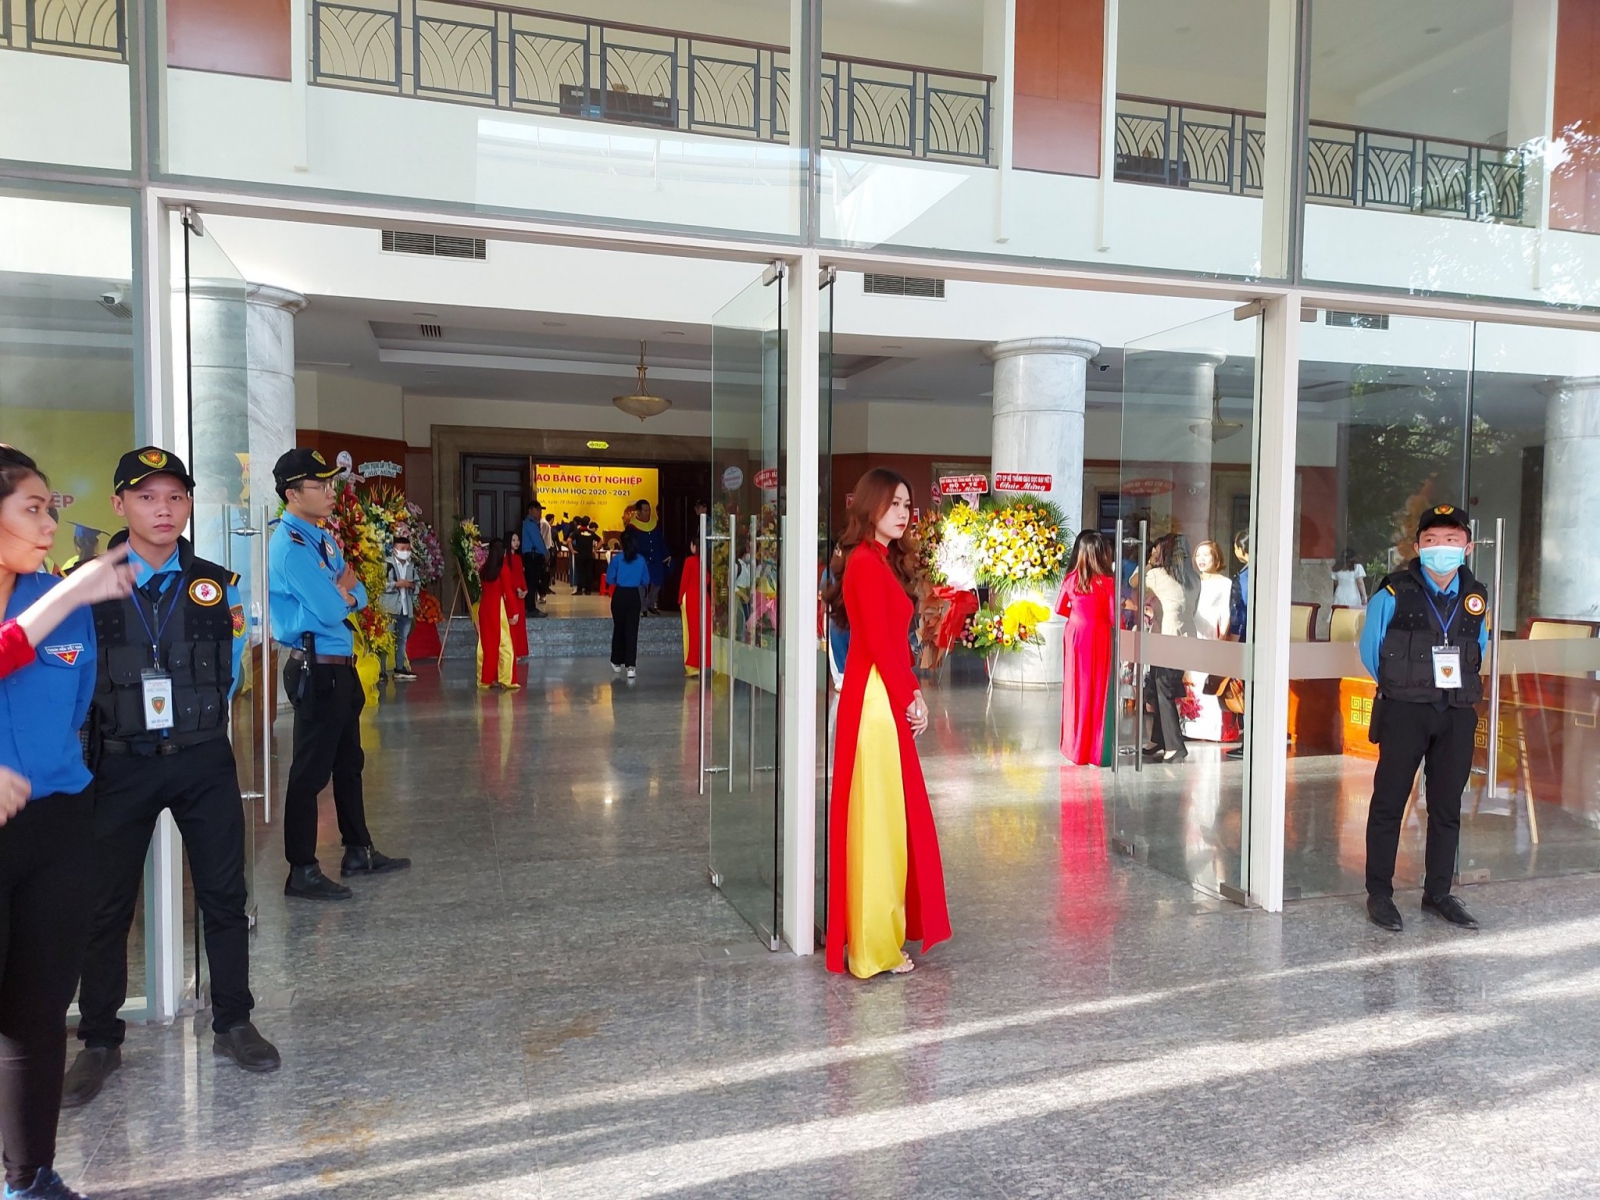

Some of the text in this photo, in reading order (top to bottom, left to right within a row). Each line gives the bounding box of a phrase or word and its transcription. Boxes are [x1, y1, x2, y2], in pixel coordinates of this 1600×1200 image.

[536, 473, 551, 482] AO
[584, 473, 602, 484] TỐT
[605, 475, 643, 487] NGHIỆP
[570, 488, 586, 496] HỌC
[588, 488, 607, 496] 2020
[613, 489, 630, 497] 2021
